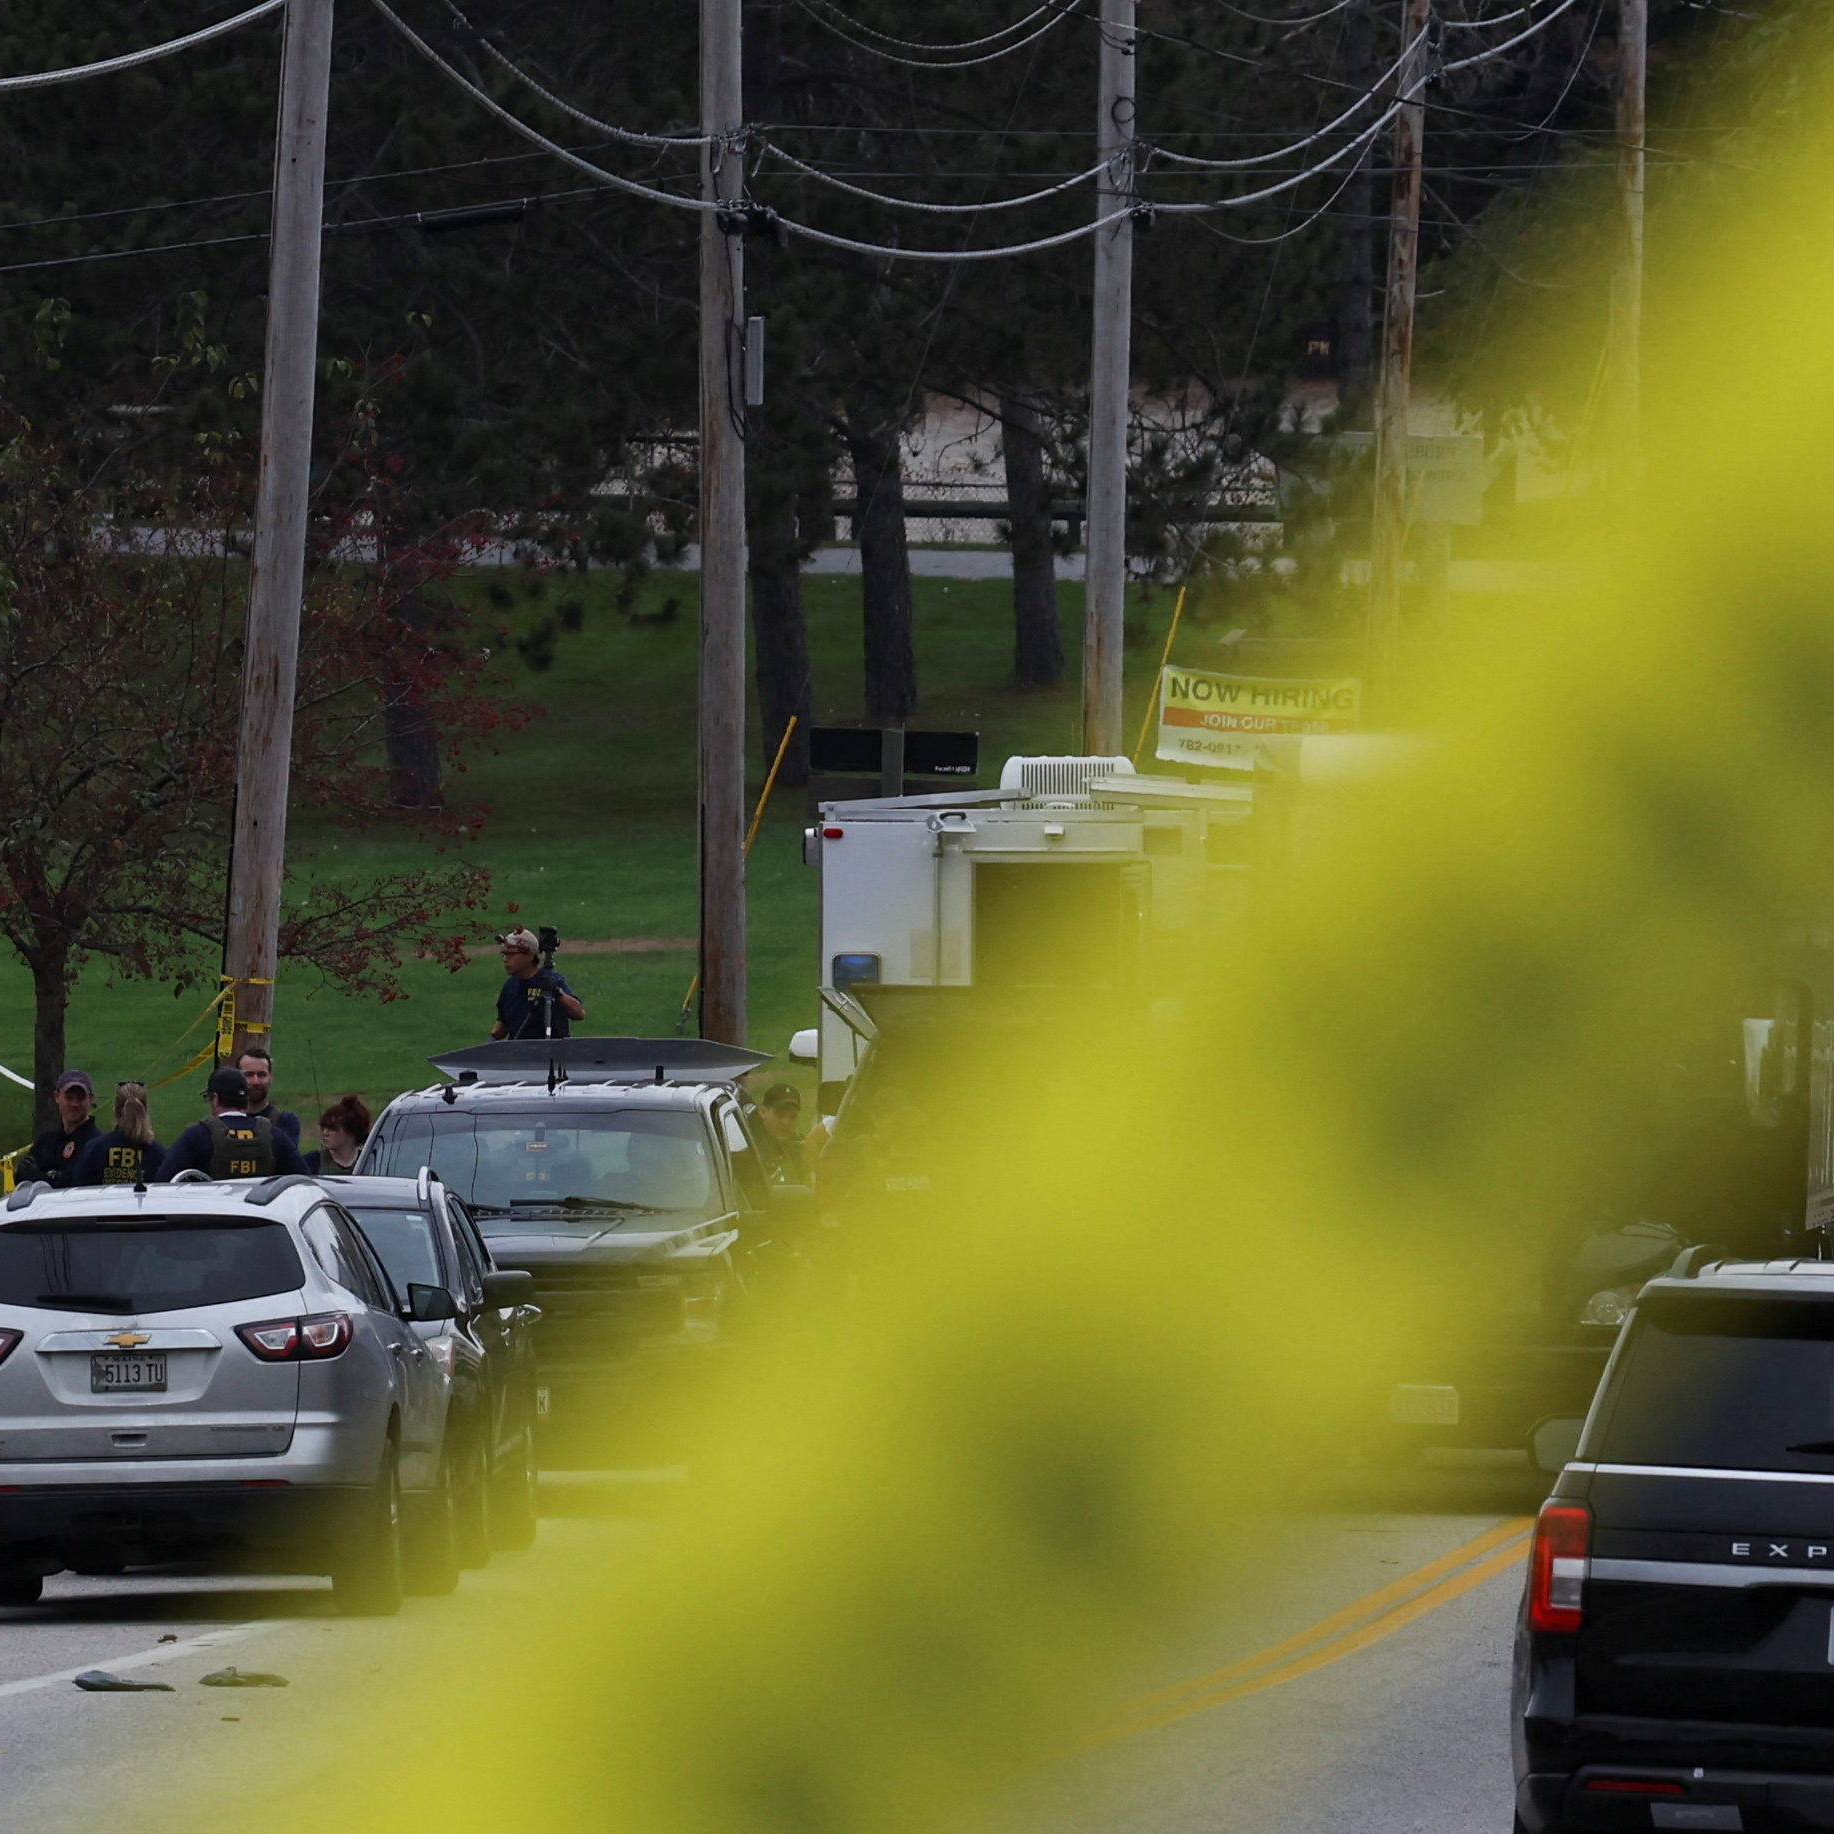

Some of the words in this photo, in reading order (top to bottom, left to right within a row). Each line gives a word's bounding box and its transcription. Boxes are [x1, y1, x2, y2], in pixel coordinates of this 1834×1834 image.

[1170, 676, 1241, 704] NOW
[1250, 686, 1356, 711] HIRING
[1200, 713, 1237, 729] JOIN
[1240, 715, 1277, 730] OUR
[230, 1160, 256, 1174] FBI
[105, 1363, 141, 1388] 5113
[145, 1362, 164, 1386] TU
